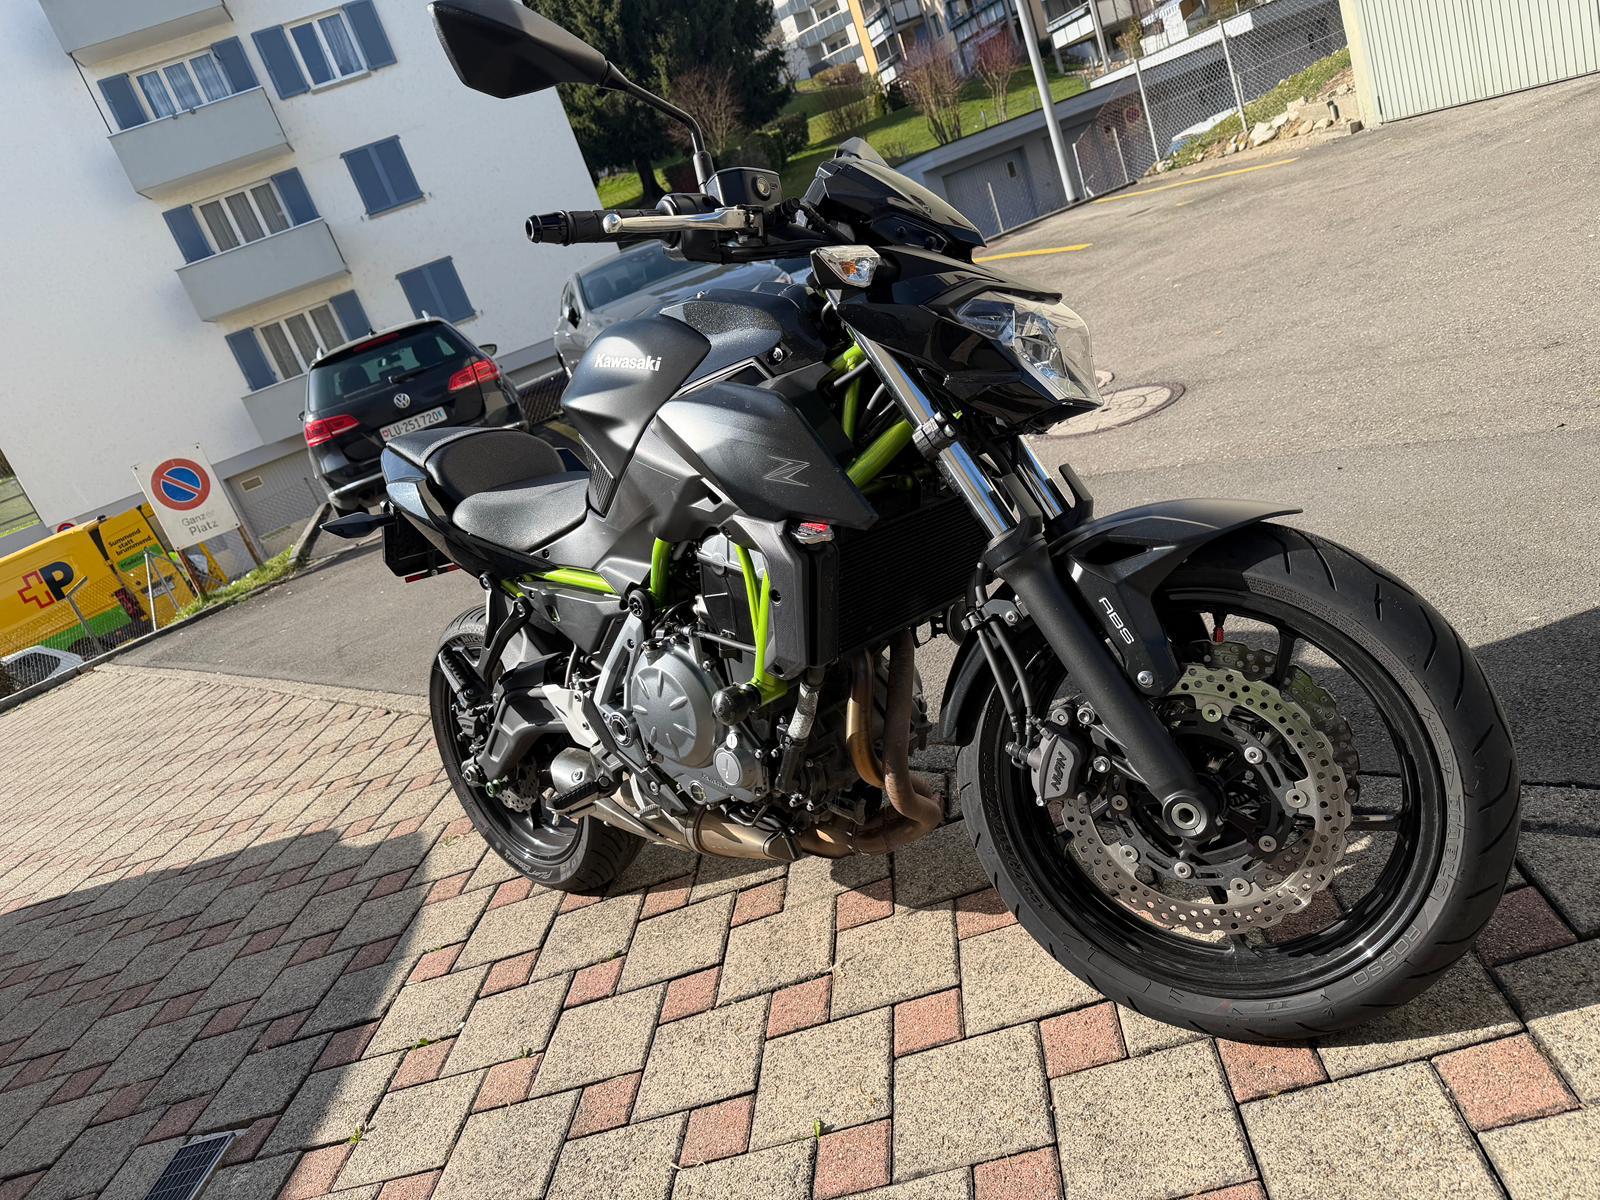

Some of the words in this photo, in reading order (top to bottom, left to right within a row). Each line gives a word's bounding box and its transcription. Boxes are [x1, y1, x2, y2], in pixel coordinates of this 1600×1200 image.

[594, 353, 662, 372] Kawasaki
[181, 509, 214, 527] Ganz
[189, 519, 219, 536] Platz
[108, 528, 141, 548] Summend
[118, 538, 134, 551] statt
[1098, 597, 1135, 645] ABS
[1351, 925, 1422, 987] ROSSO
